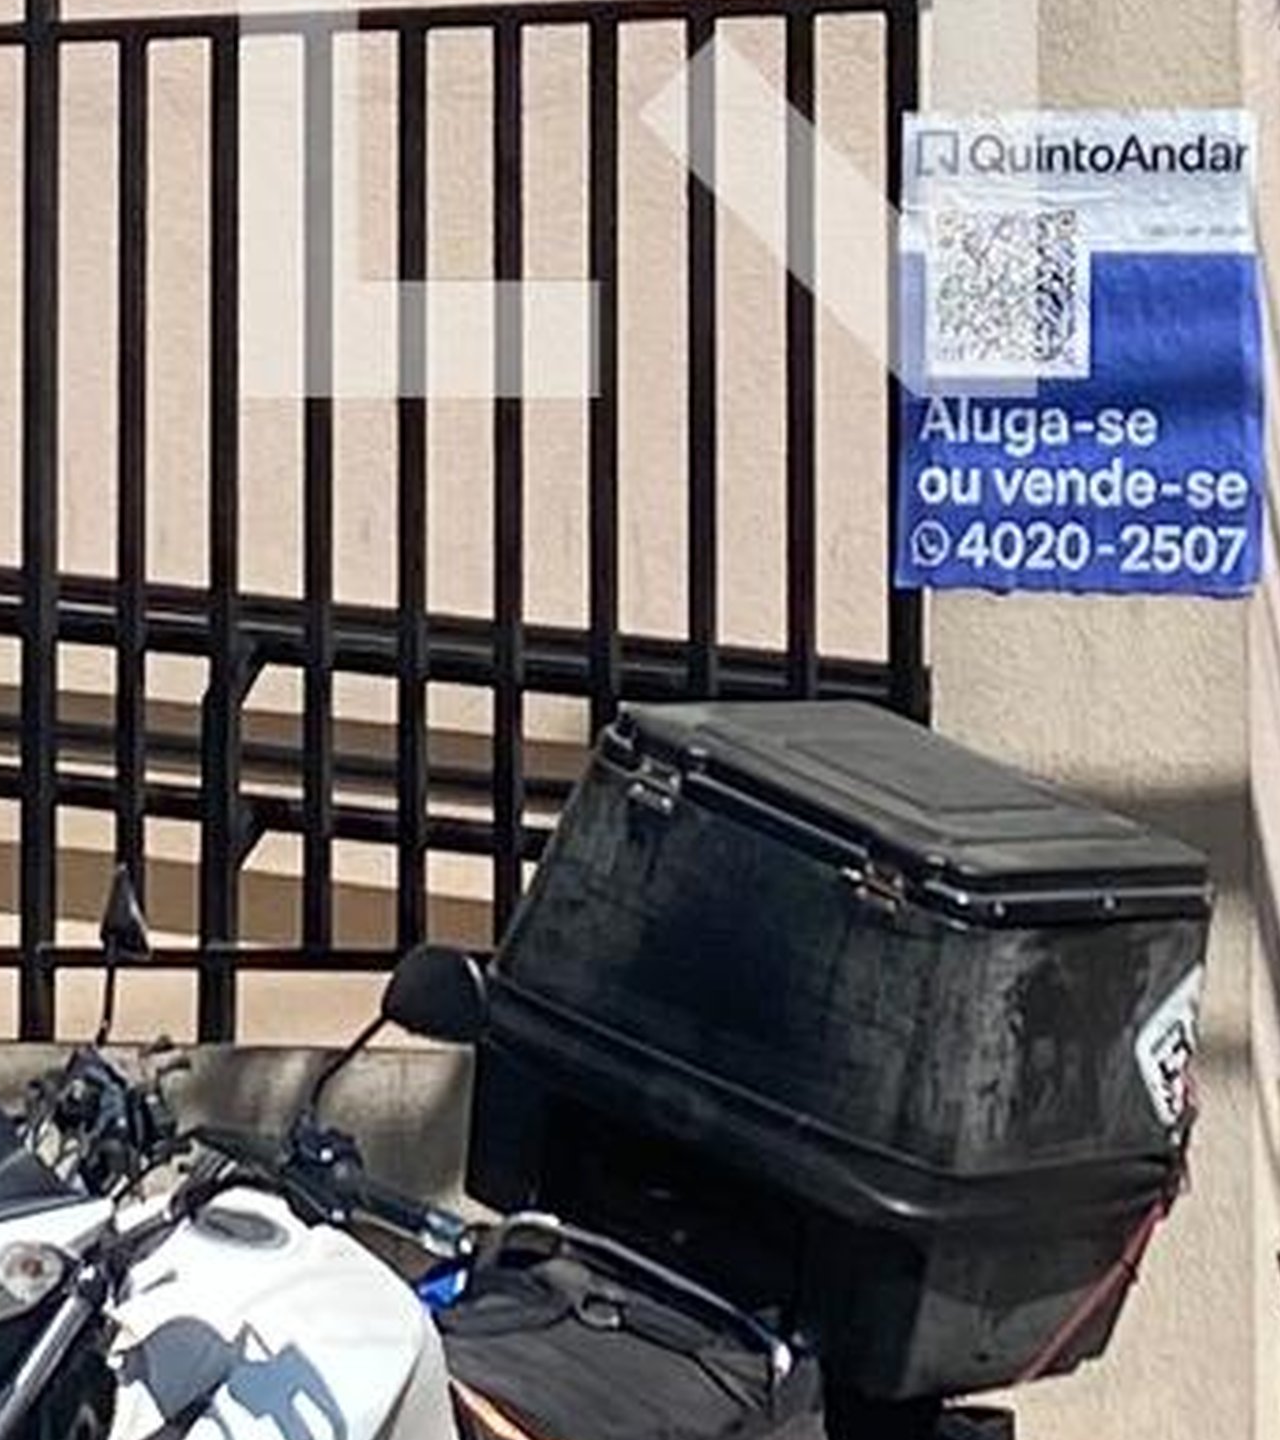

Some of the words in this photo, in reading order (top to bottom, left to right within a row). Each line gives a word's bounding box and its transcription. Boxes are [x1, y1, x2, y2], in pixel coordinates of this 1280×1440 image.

[969, 133, 1249, 173] QuintoAndar
[920, 399, 1158, 457] Aluga-se
[917, 467, 981, 506] ou
[994, 458, 1249, 509] vende-se
[955, 521, 1249, 575] 4020-2507
